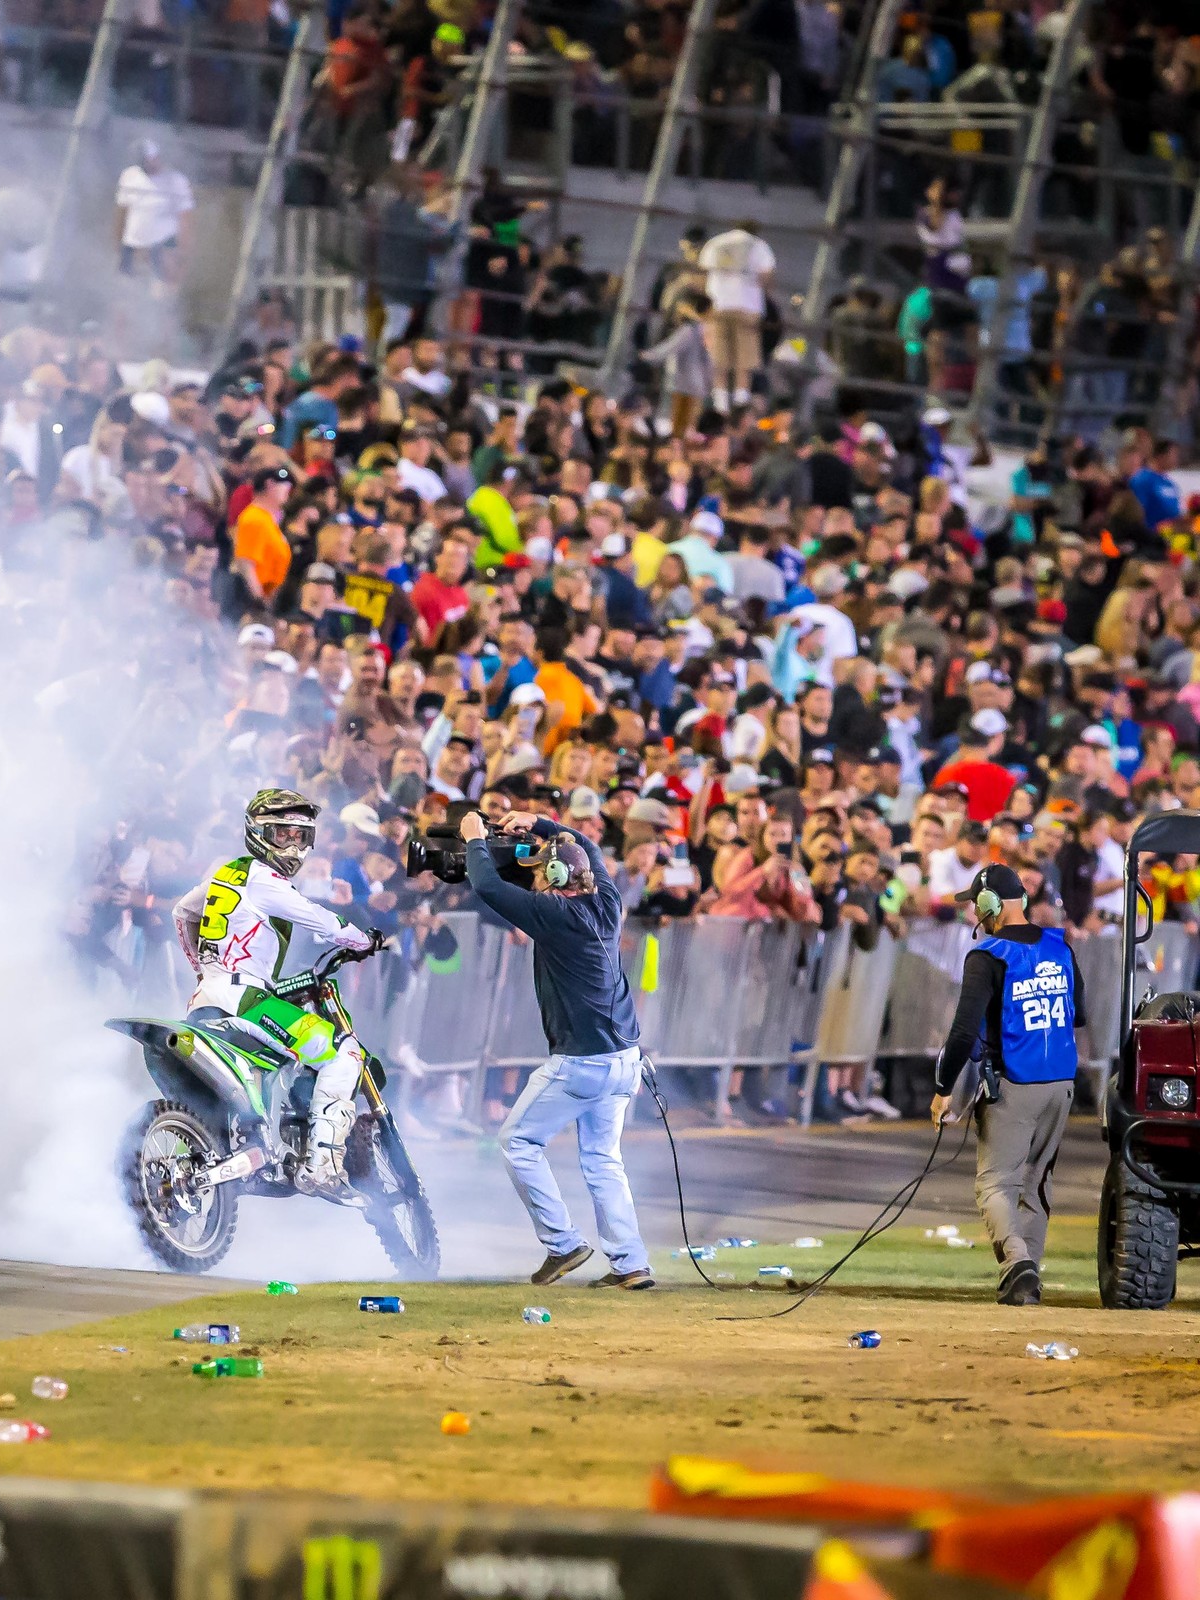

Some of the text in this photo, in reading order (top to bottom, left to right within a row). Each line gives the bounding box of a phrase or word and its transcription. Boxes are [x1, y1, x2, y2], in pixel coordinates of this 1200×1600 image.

[199, 881, 242, 940] 3
[275, 972, 312, 989] RENTHAL
[277, 978, 315, 995] RENTHAL
[1012, 975, 1068, 996] DAYTONA
[1022, 996, 1066, 1031] 234
